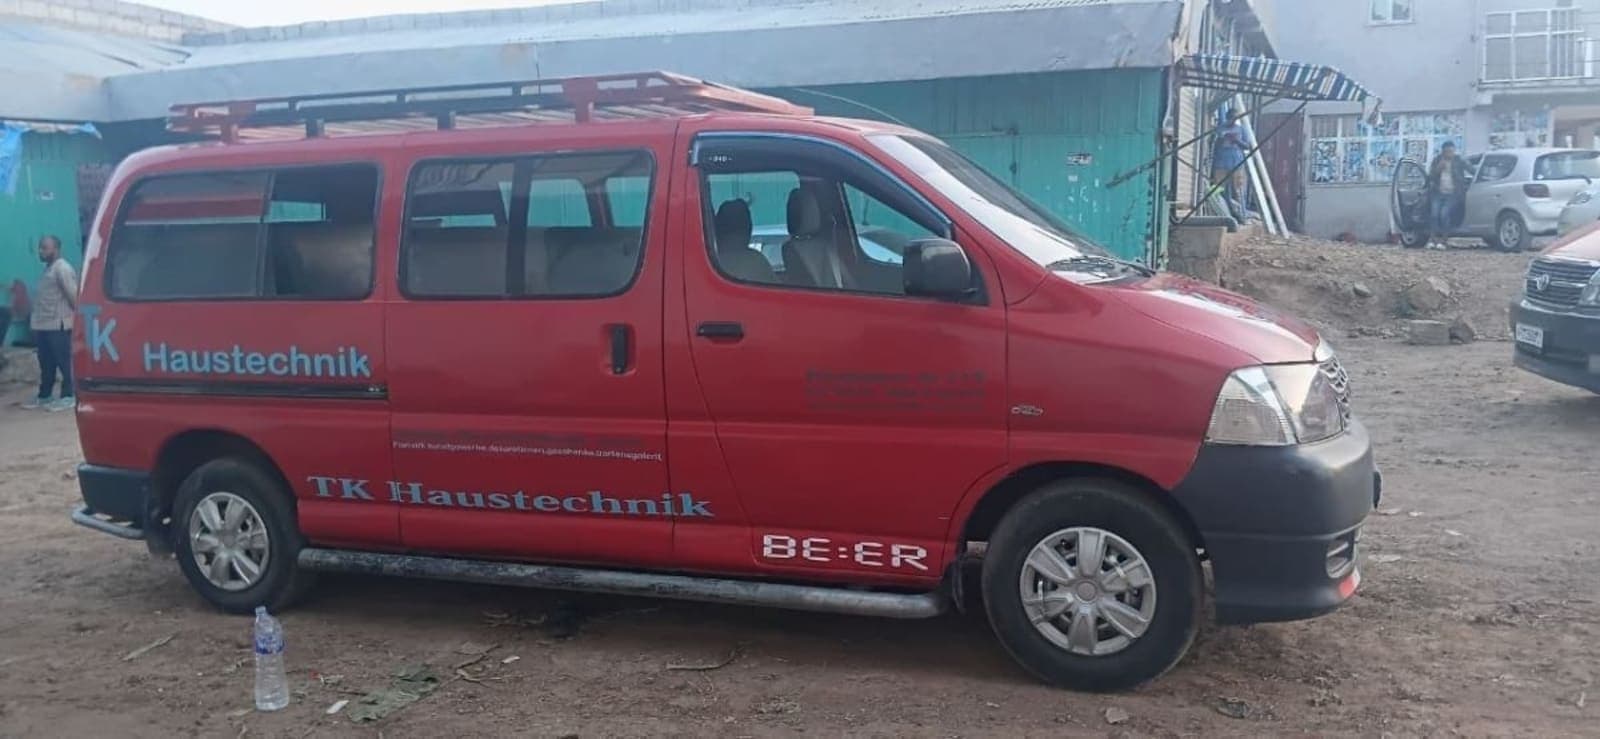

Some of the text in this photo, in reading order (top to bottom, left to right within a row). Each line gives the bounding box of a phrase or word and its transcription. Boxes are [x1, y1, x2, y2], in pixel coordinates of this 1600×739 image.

[80, 305, 370, 377] TK Haustechnik
[308, 475, 714, 517] TK Haustechnik
[763, 534, 928, 570] BE:ER
